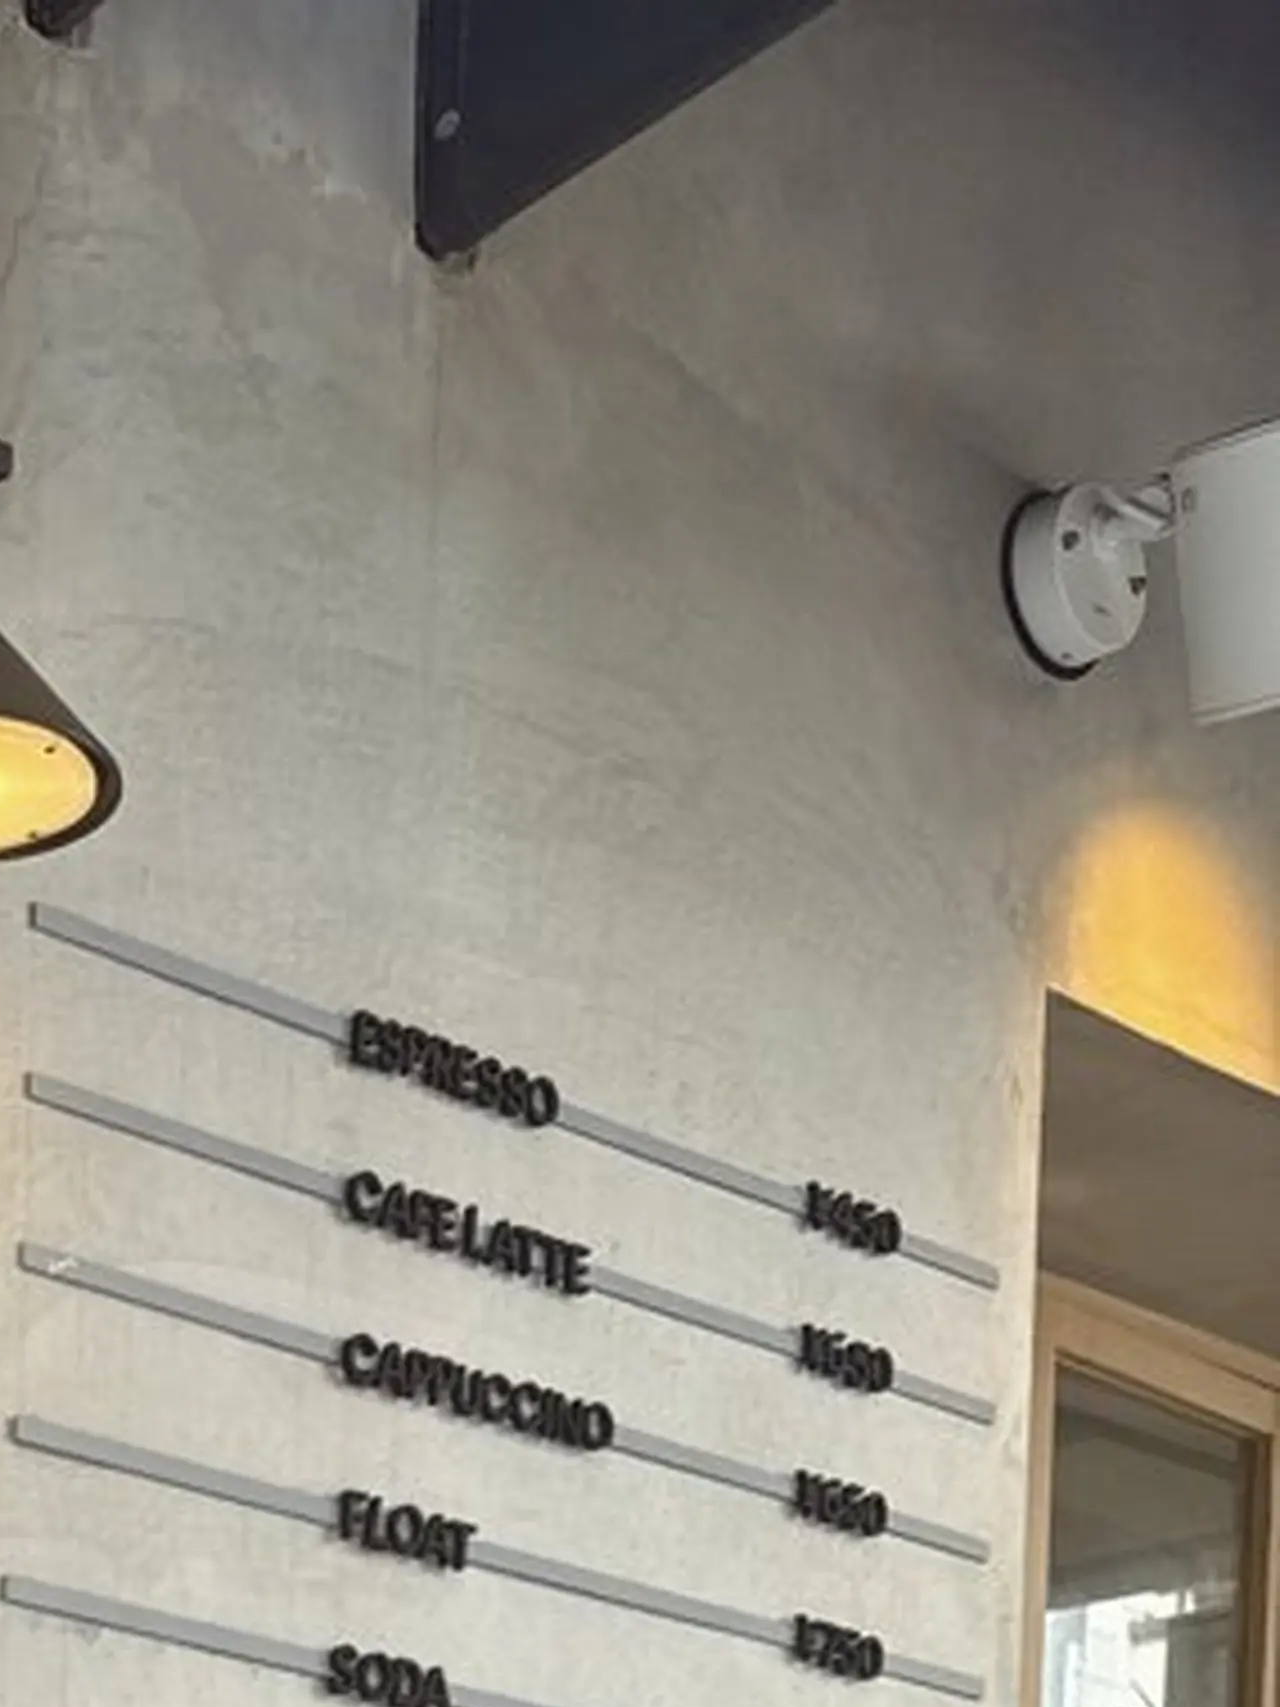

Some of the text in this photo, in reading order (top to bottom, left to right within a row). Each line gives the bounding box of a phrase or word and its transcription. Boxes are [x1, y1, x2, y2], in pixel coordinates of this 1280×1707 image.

[348, 1009, 561, 1127] ESPRESSO
[343, 1170, 458, 1252] CAFE
[459, 1205, 593, 1296] LATTE
[340, 1333, 615, 1451] CAPPUCCINO
[336, 1490, 477, 1572] FLOAT
